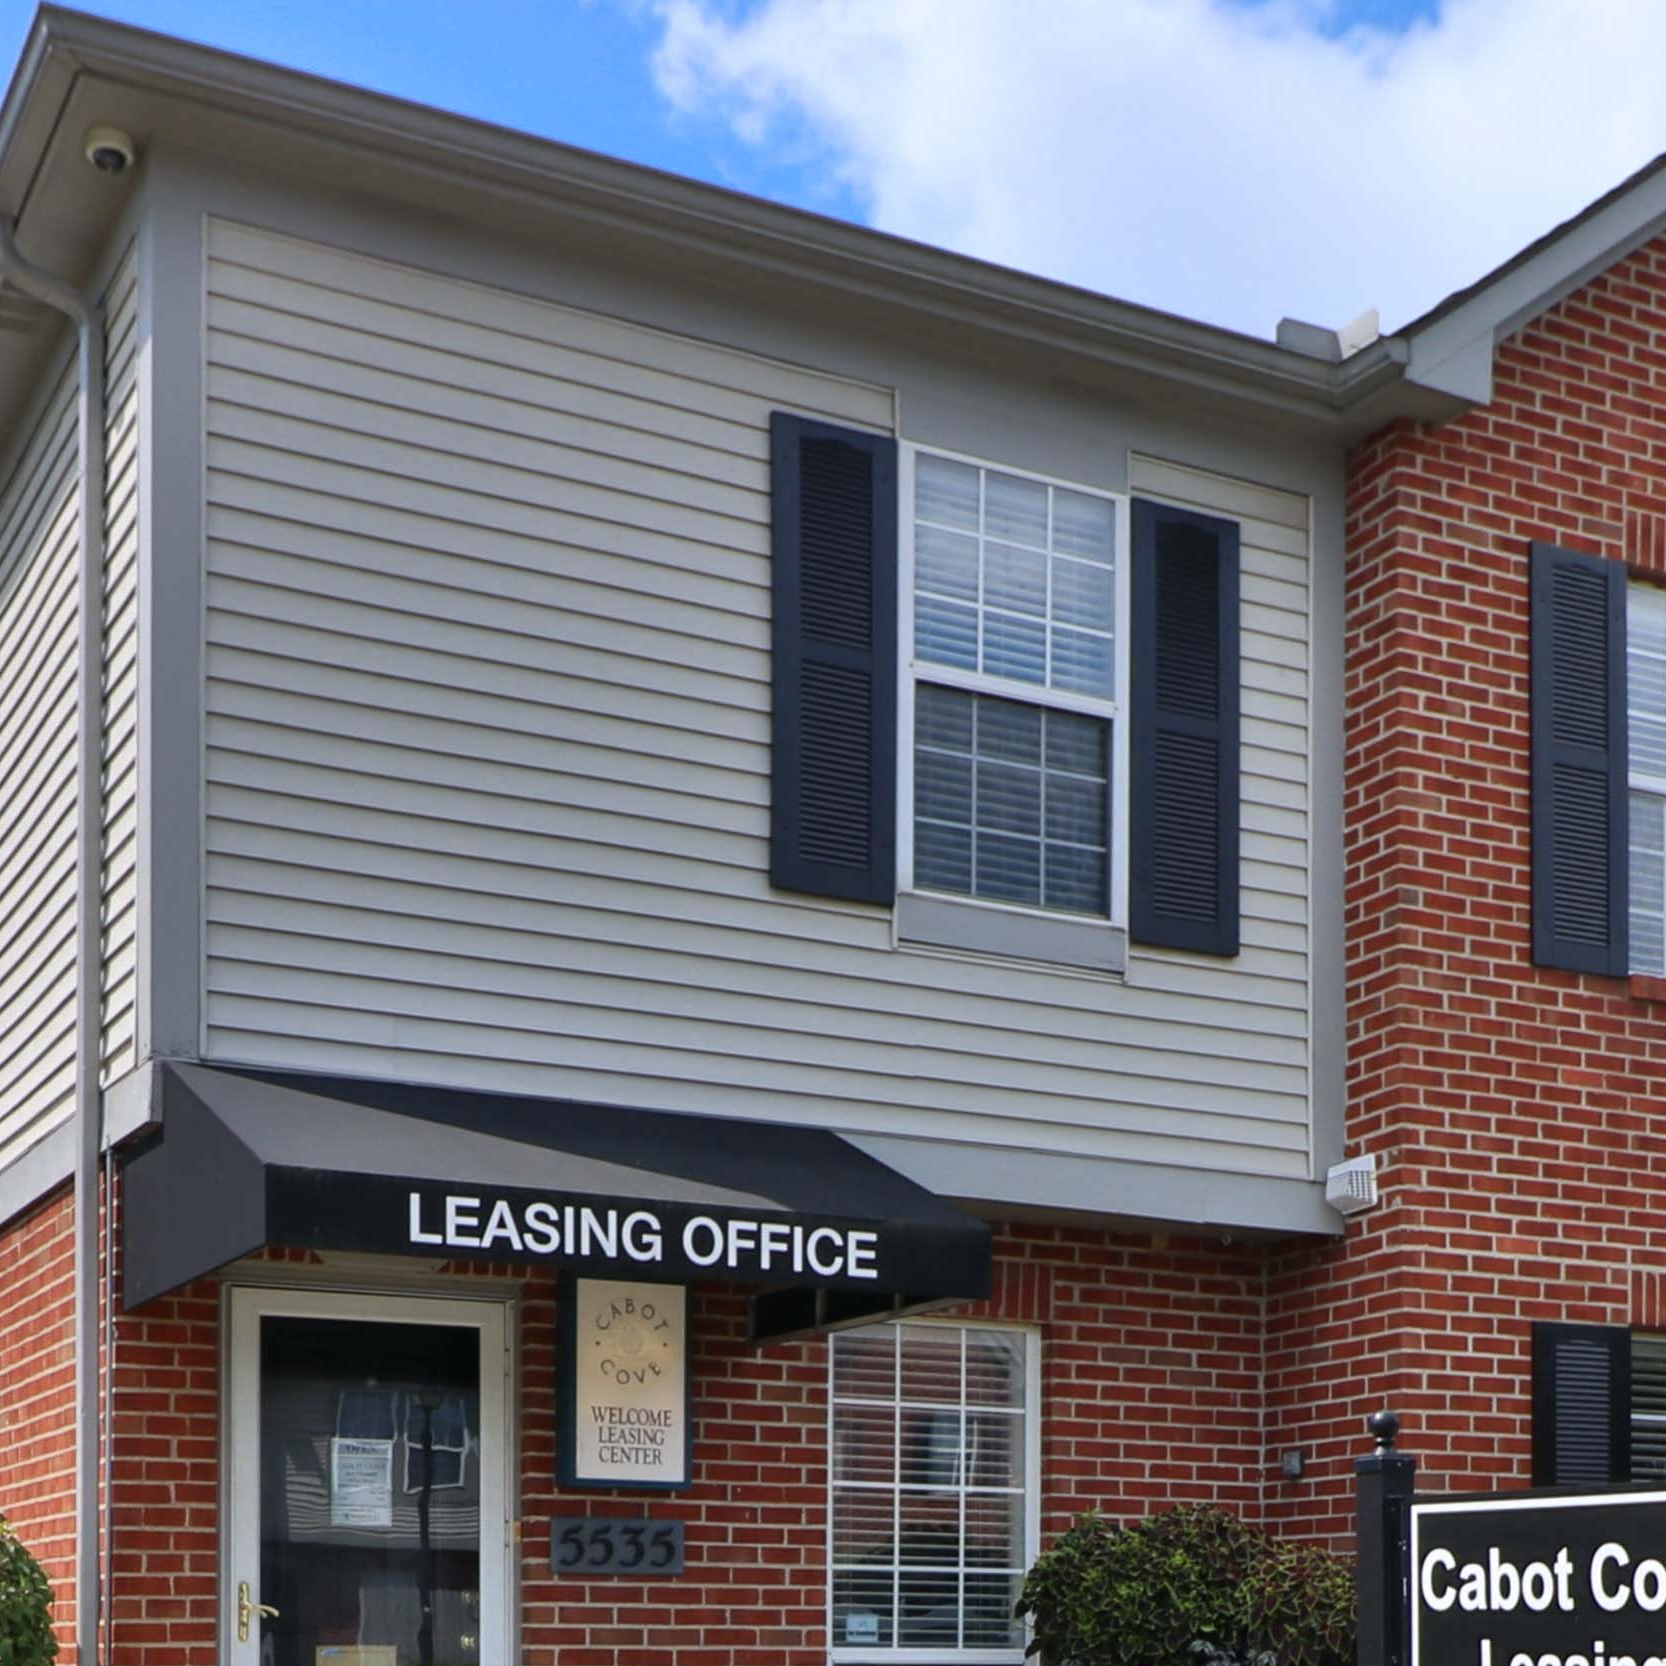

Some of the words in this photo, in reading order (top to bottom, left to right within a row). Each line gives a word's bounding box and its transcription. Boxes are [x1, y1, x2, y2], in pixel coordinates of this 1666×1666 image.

[409, 1192, 663, 1262] LEASING
[682, 1216, 879, 1279] OFFICE
[595, 1298, 668, 1331] CABOT
[600, 1359, 662, 1385] COVE
[591, 1406, 673, 1427] WELCOME
[598, 1426, 665, 1446] LEASING
[598, 1446, 663, 1465] CENTER
[559, 1524, 676, 1567] 5535
[1421, 1547, 1575, 1612] Cabot
